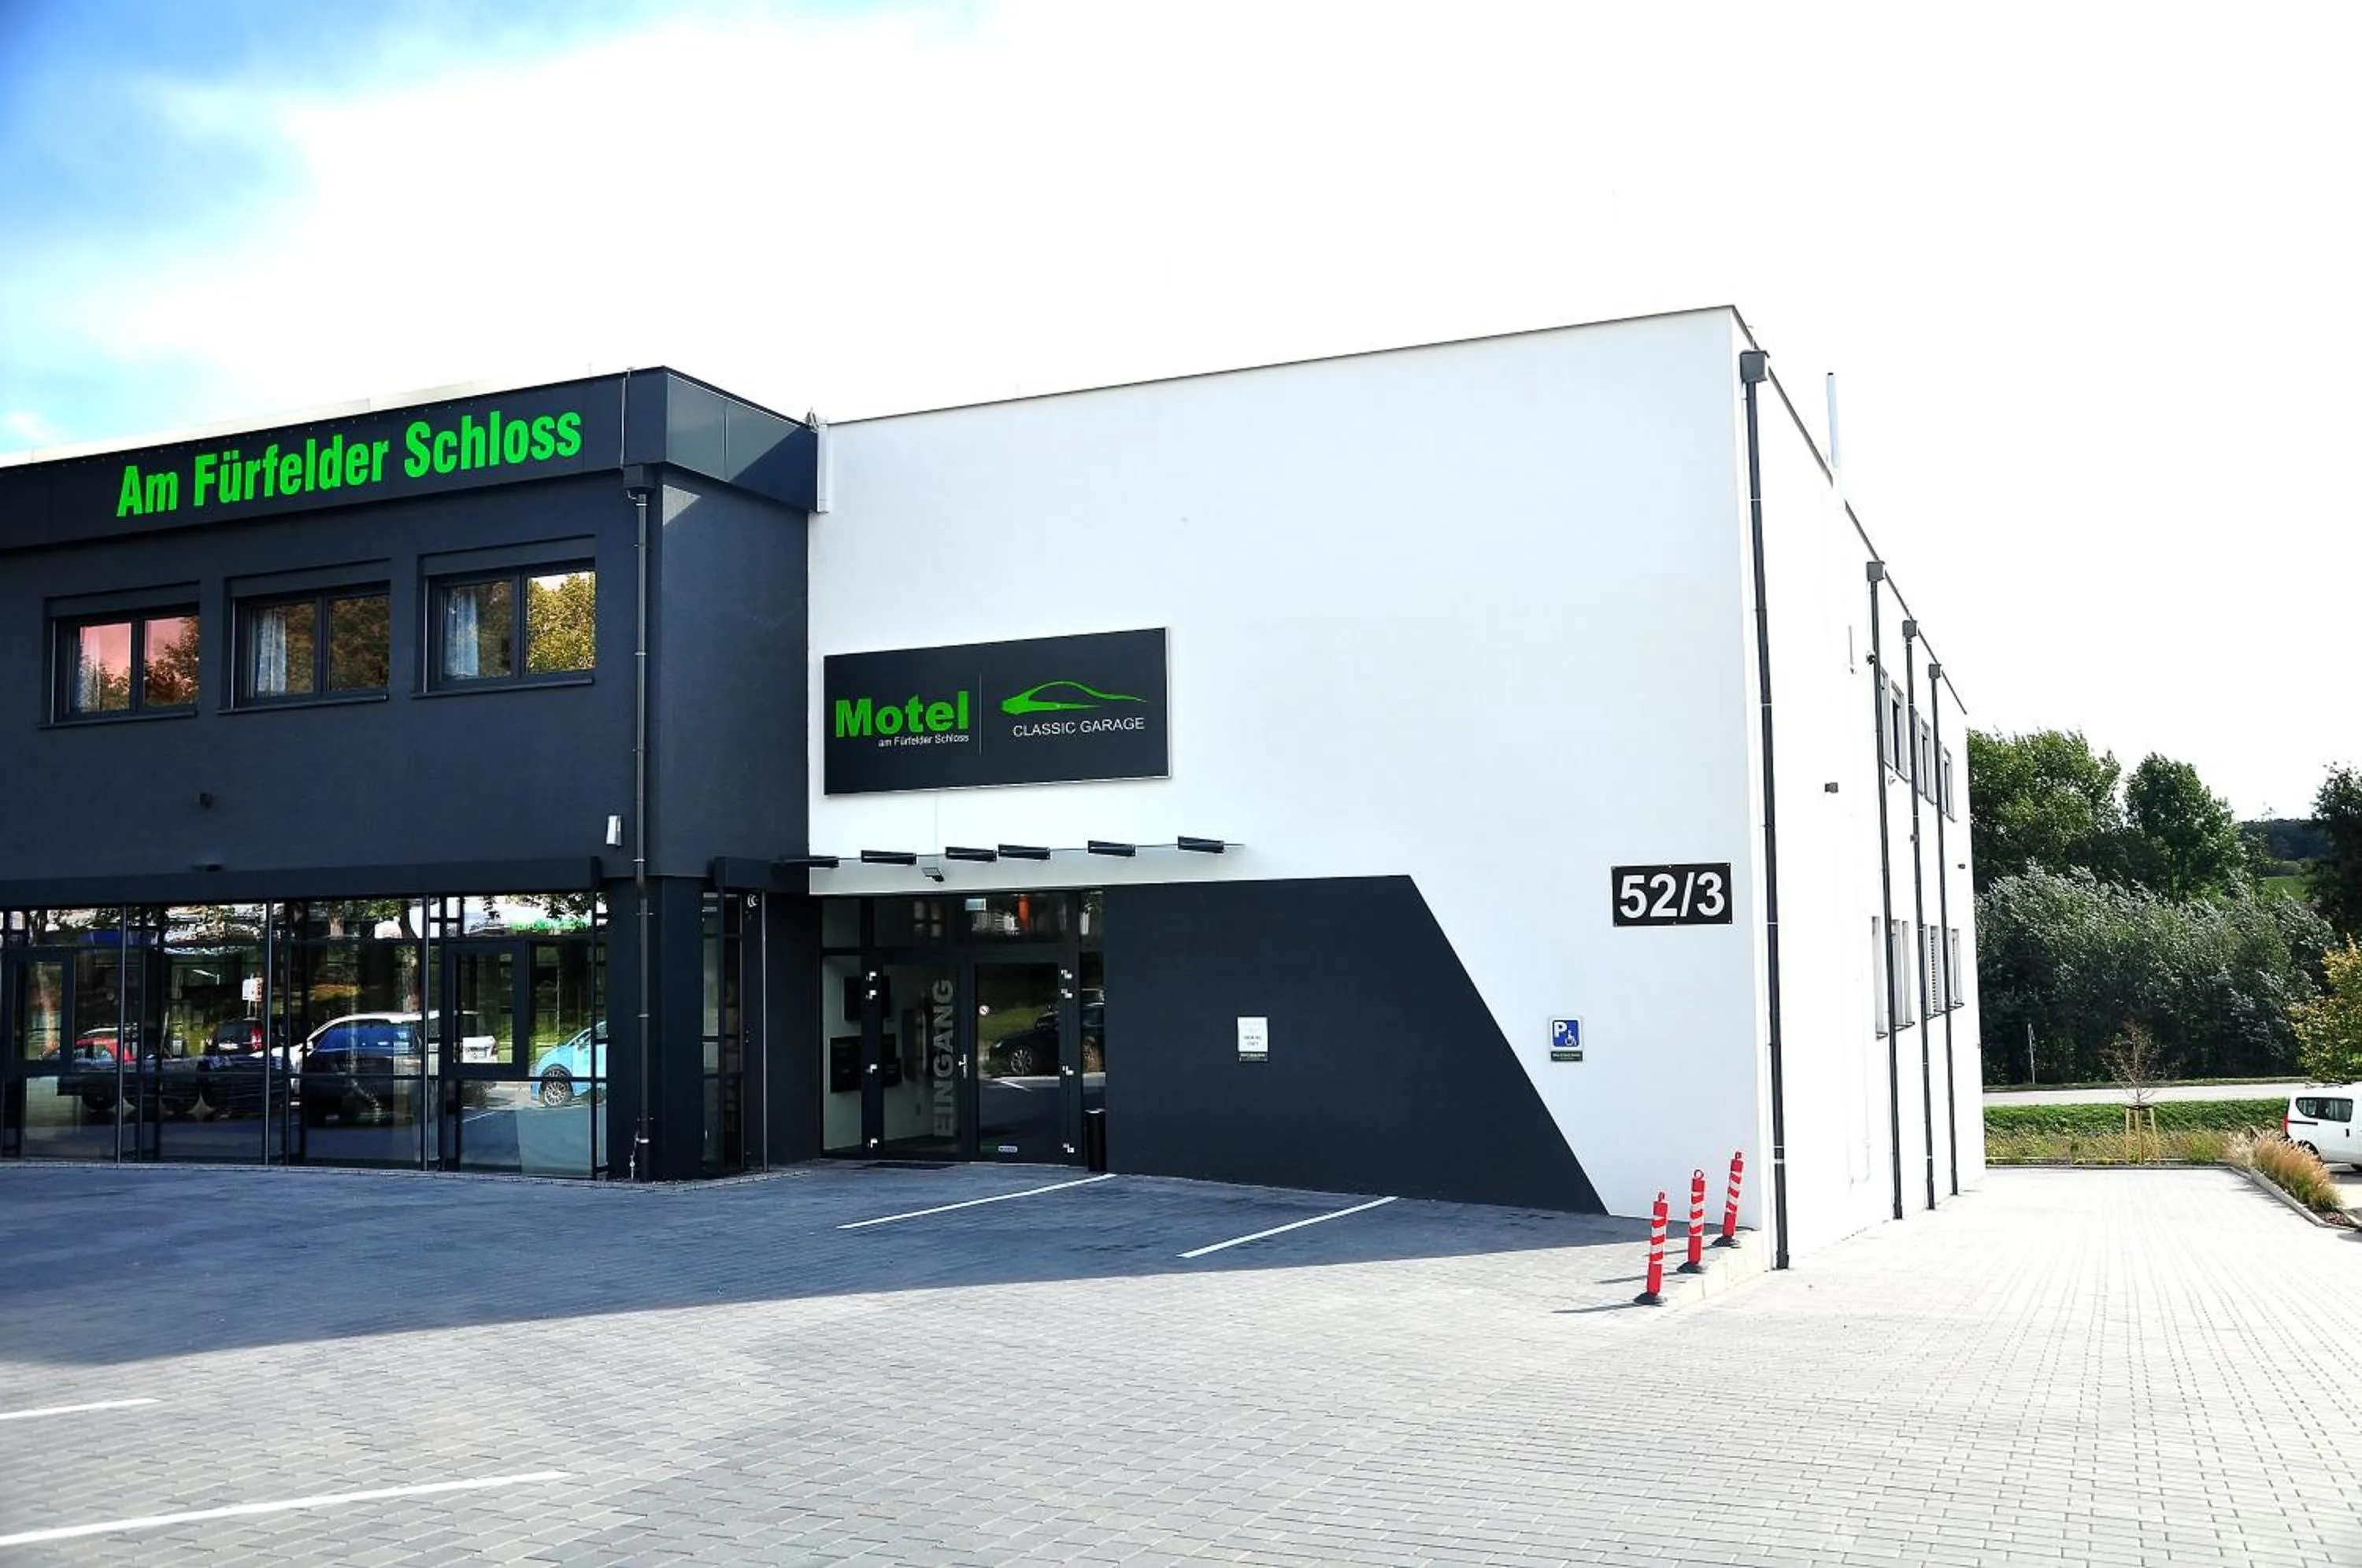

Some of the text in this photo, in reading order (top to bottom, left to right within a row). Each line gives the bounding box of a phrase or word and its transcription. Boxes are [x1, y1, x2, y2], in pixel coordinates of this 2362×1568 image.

[117, 410, 581, 517] Am Fürfelder Schloss
[835, 690, 970, 738] Motel
[1013, 717, 1145, 738] CLASSIC GARAGE
[878, 733, 969, 747] am Fürfelder Schloss
[1620, 871, 1725, 919] 52/3
[1553, 1021, 1568, 1038] P
[932, 980, 954, 1137] EINGANG
